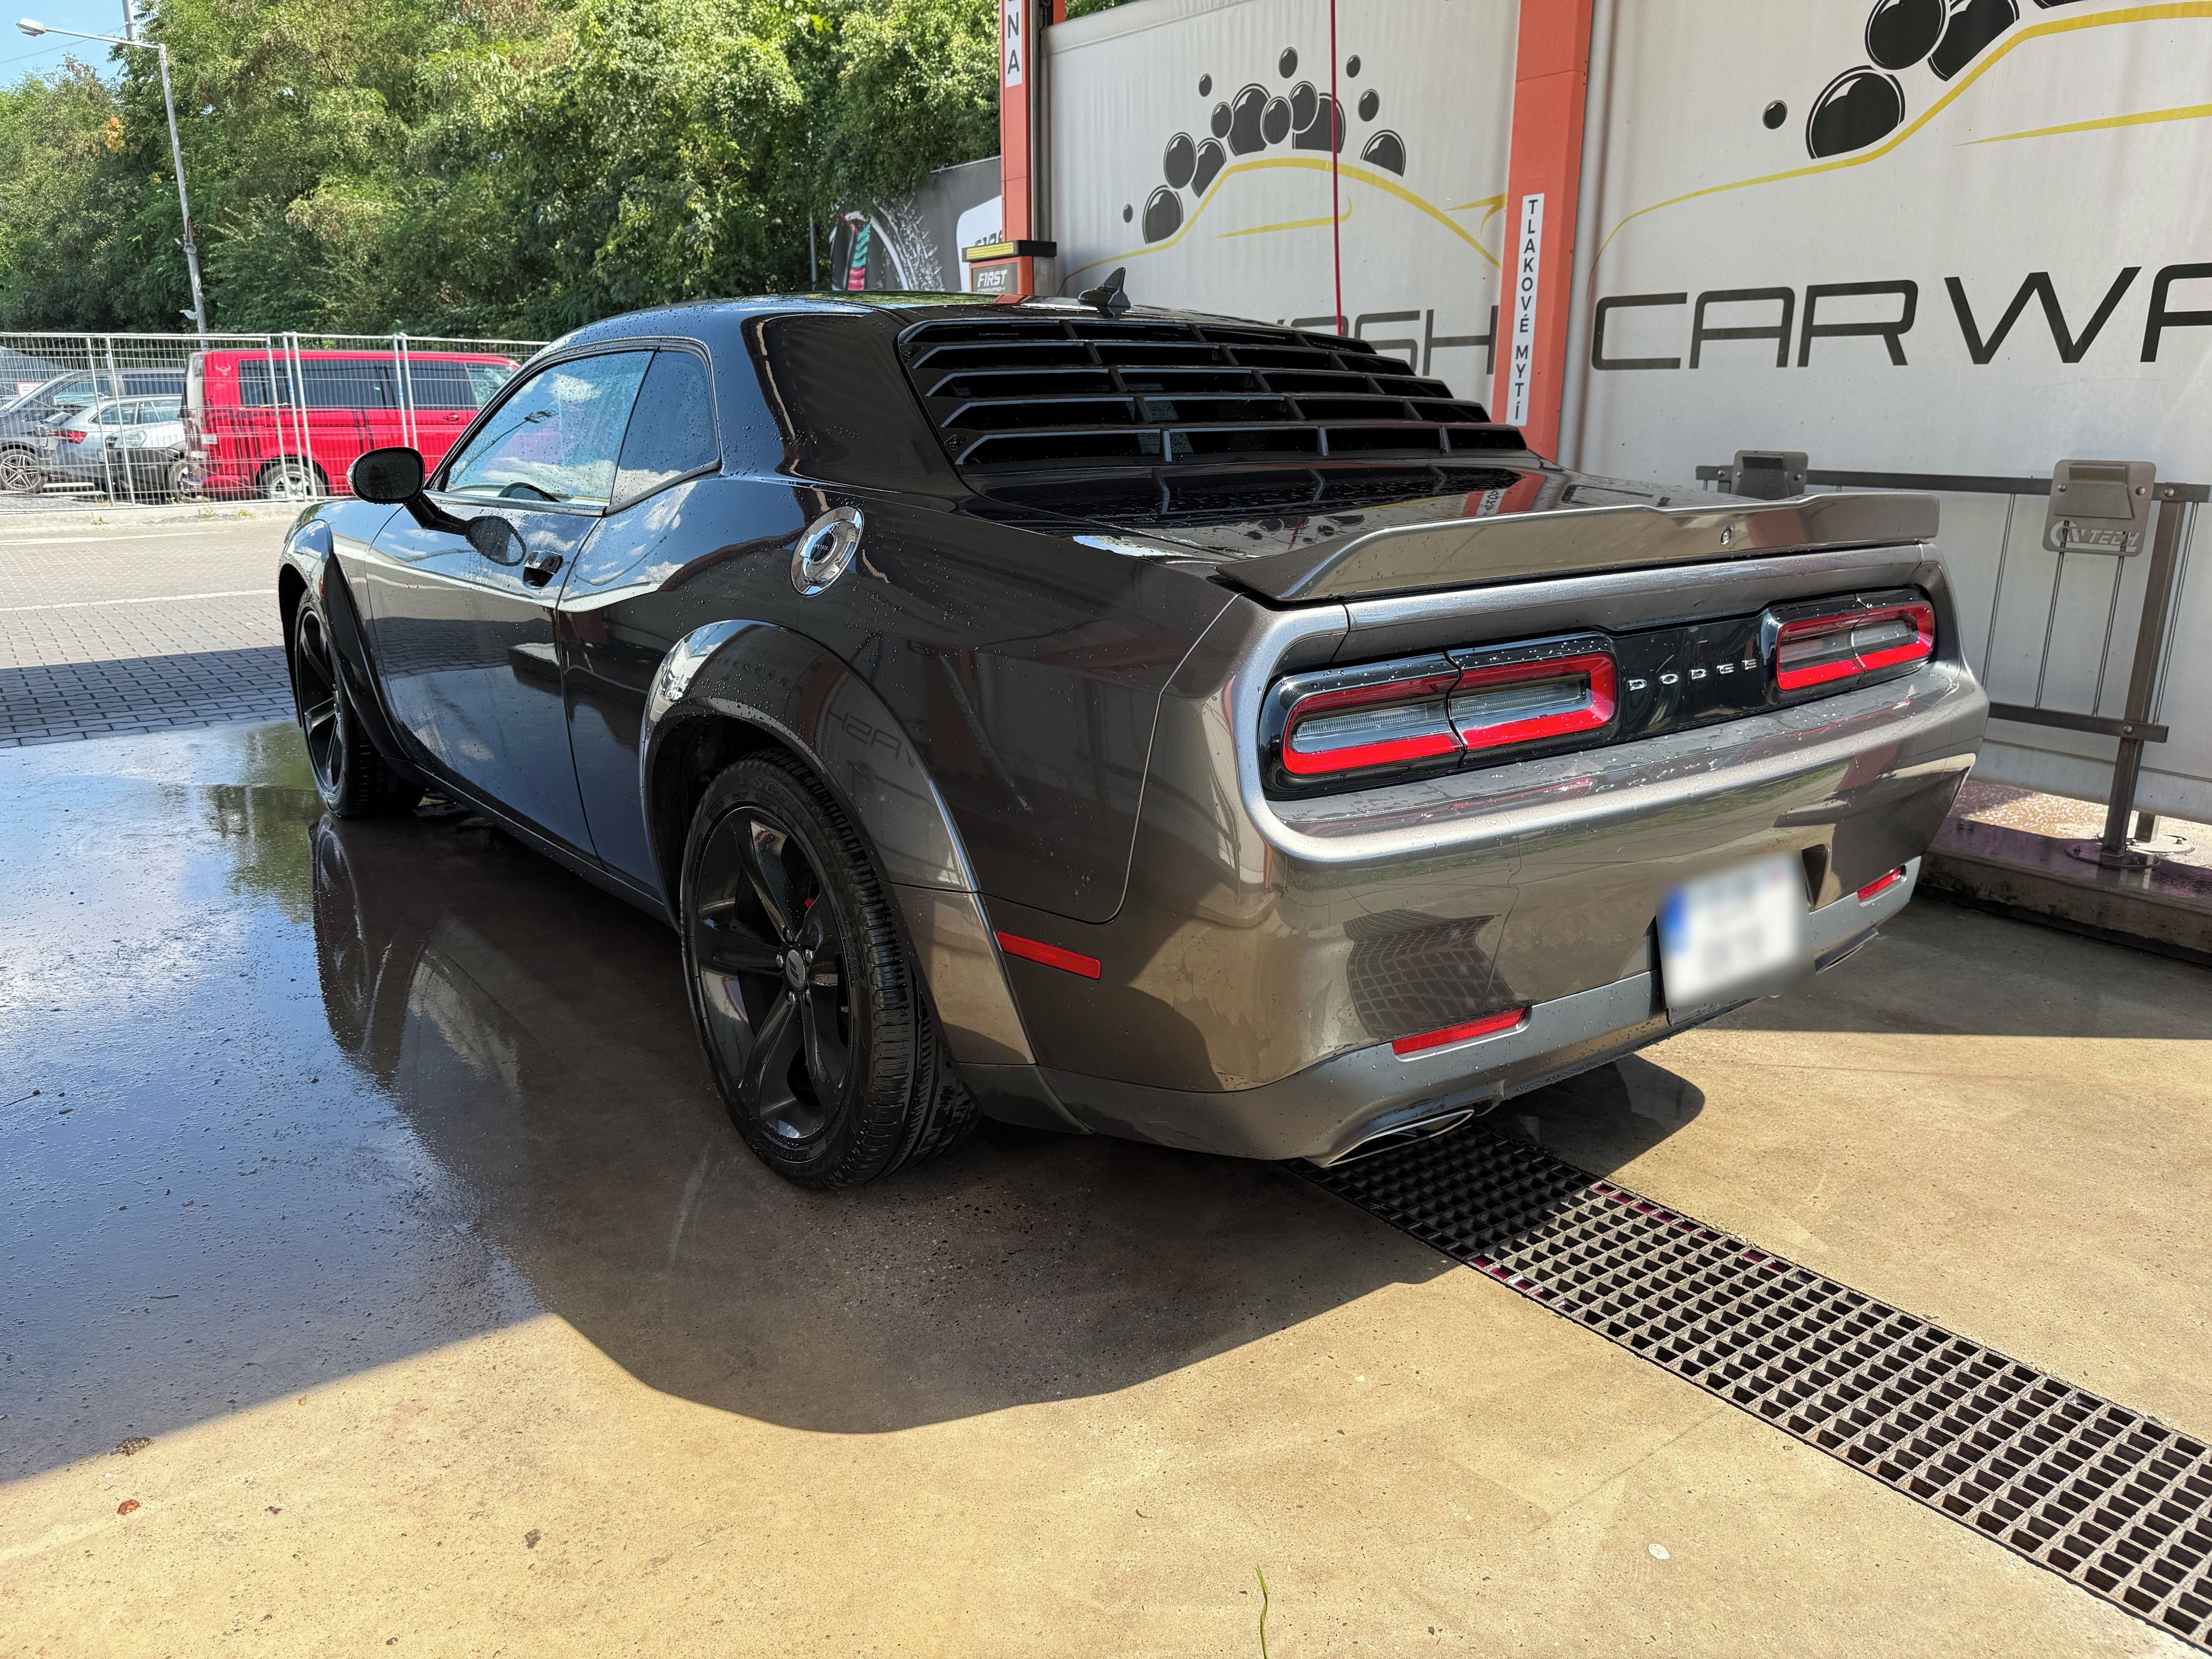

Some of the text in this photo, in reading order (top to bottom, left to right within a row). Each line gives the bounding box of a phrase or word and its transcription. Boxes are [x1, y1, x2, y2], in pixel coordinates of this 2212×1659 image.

[1007, 0, 1020, 75] NA
[977, 269, 1008, 288] FIRST
[1515, 199, 1538, 420] TLAKOVÉ MYTÍ
[2088, 529, 2140, 546] TECH
[1628, 658, 1757, 691] DODGE
[753, 773, 845, 894] SCORPION
